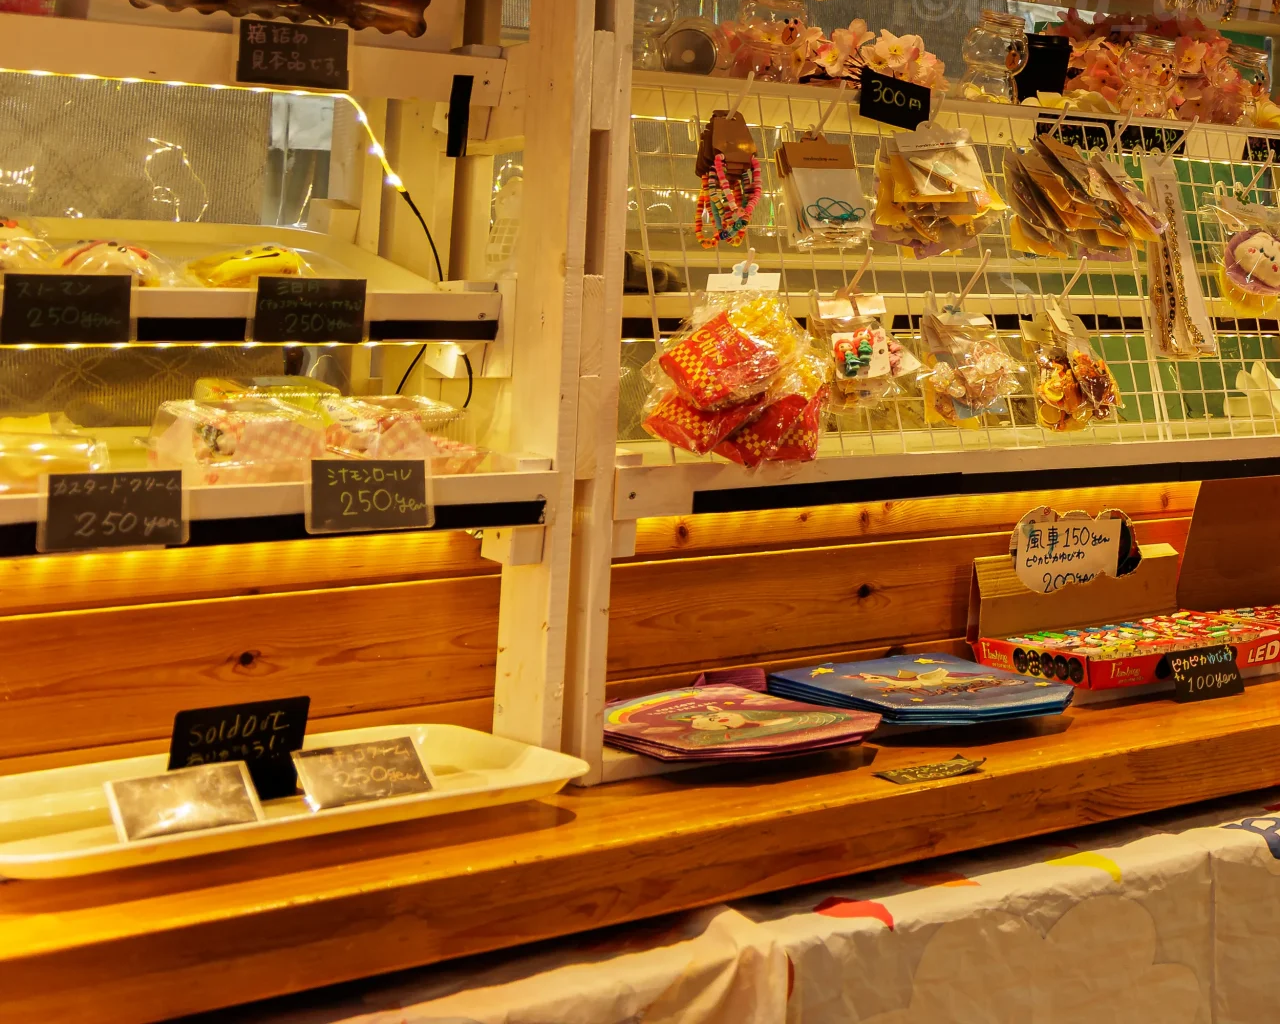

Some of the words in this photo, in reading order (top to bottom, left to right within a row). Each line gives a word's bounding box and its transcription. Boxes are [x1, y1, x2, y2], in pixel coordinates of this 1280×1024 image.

[247, 24, 309, 44] 箱詰め
[327, 467, 413, 486] シナモンロール
[1247, 639, 1280, 664] LED
